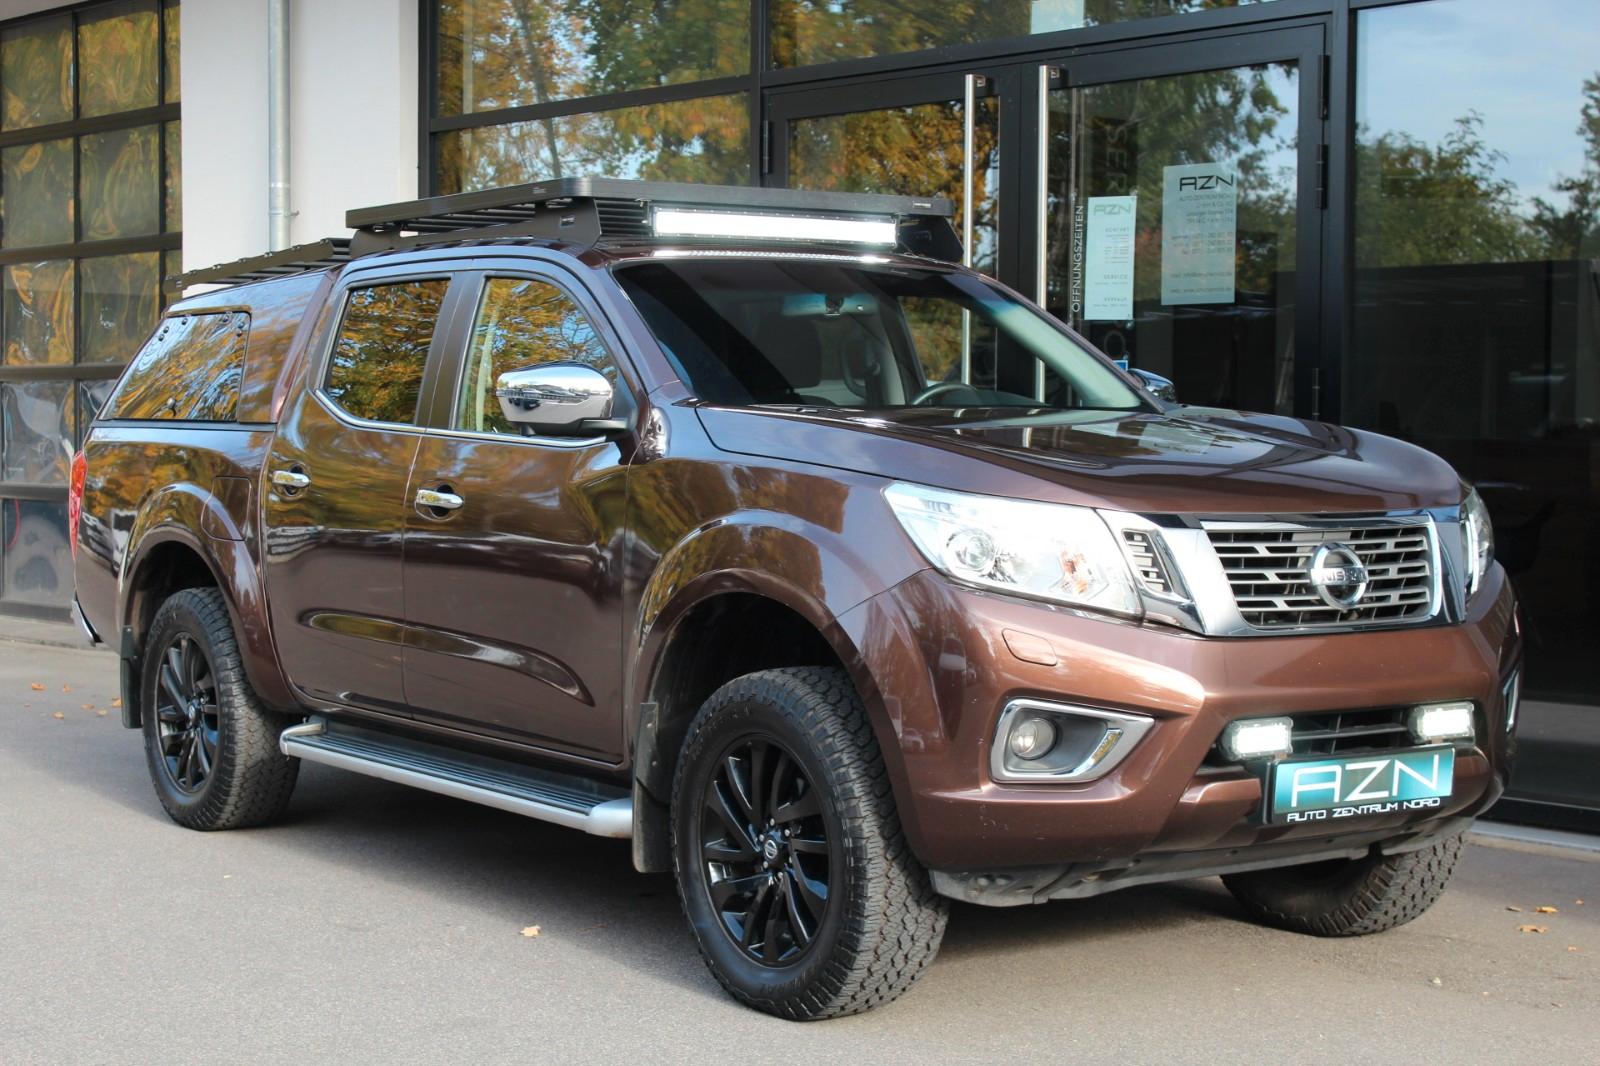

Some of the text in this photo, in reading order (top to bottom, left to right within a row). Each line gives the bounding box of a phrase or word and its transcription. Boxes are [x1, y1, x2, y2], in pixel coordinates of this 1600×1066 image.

[1180, 174, 1234, 191] AZN
[1291, 754, 1440, 808] AZN
[1287, 797, 1441, 823] AUTO ZENTRUM NORD
